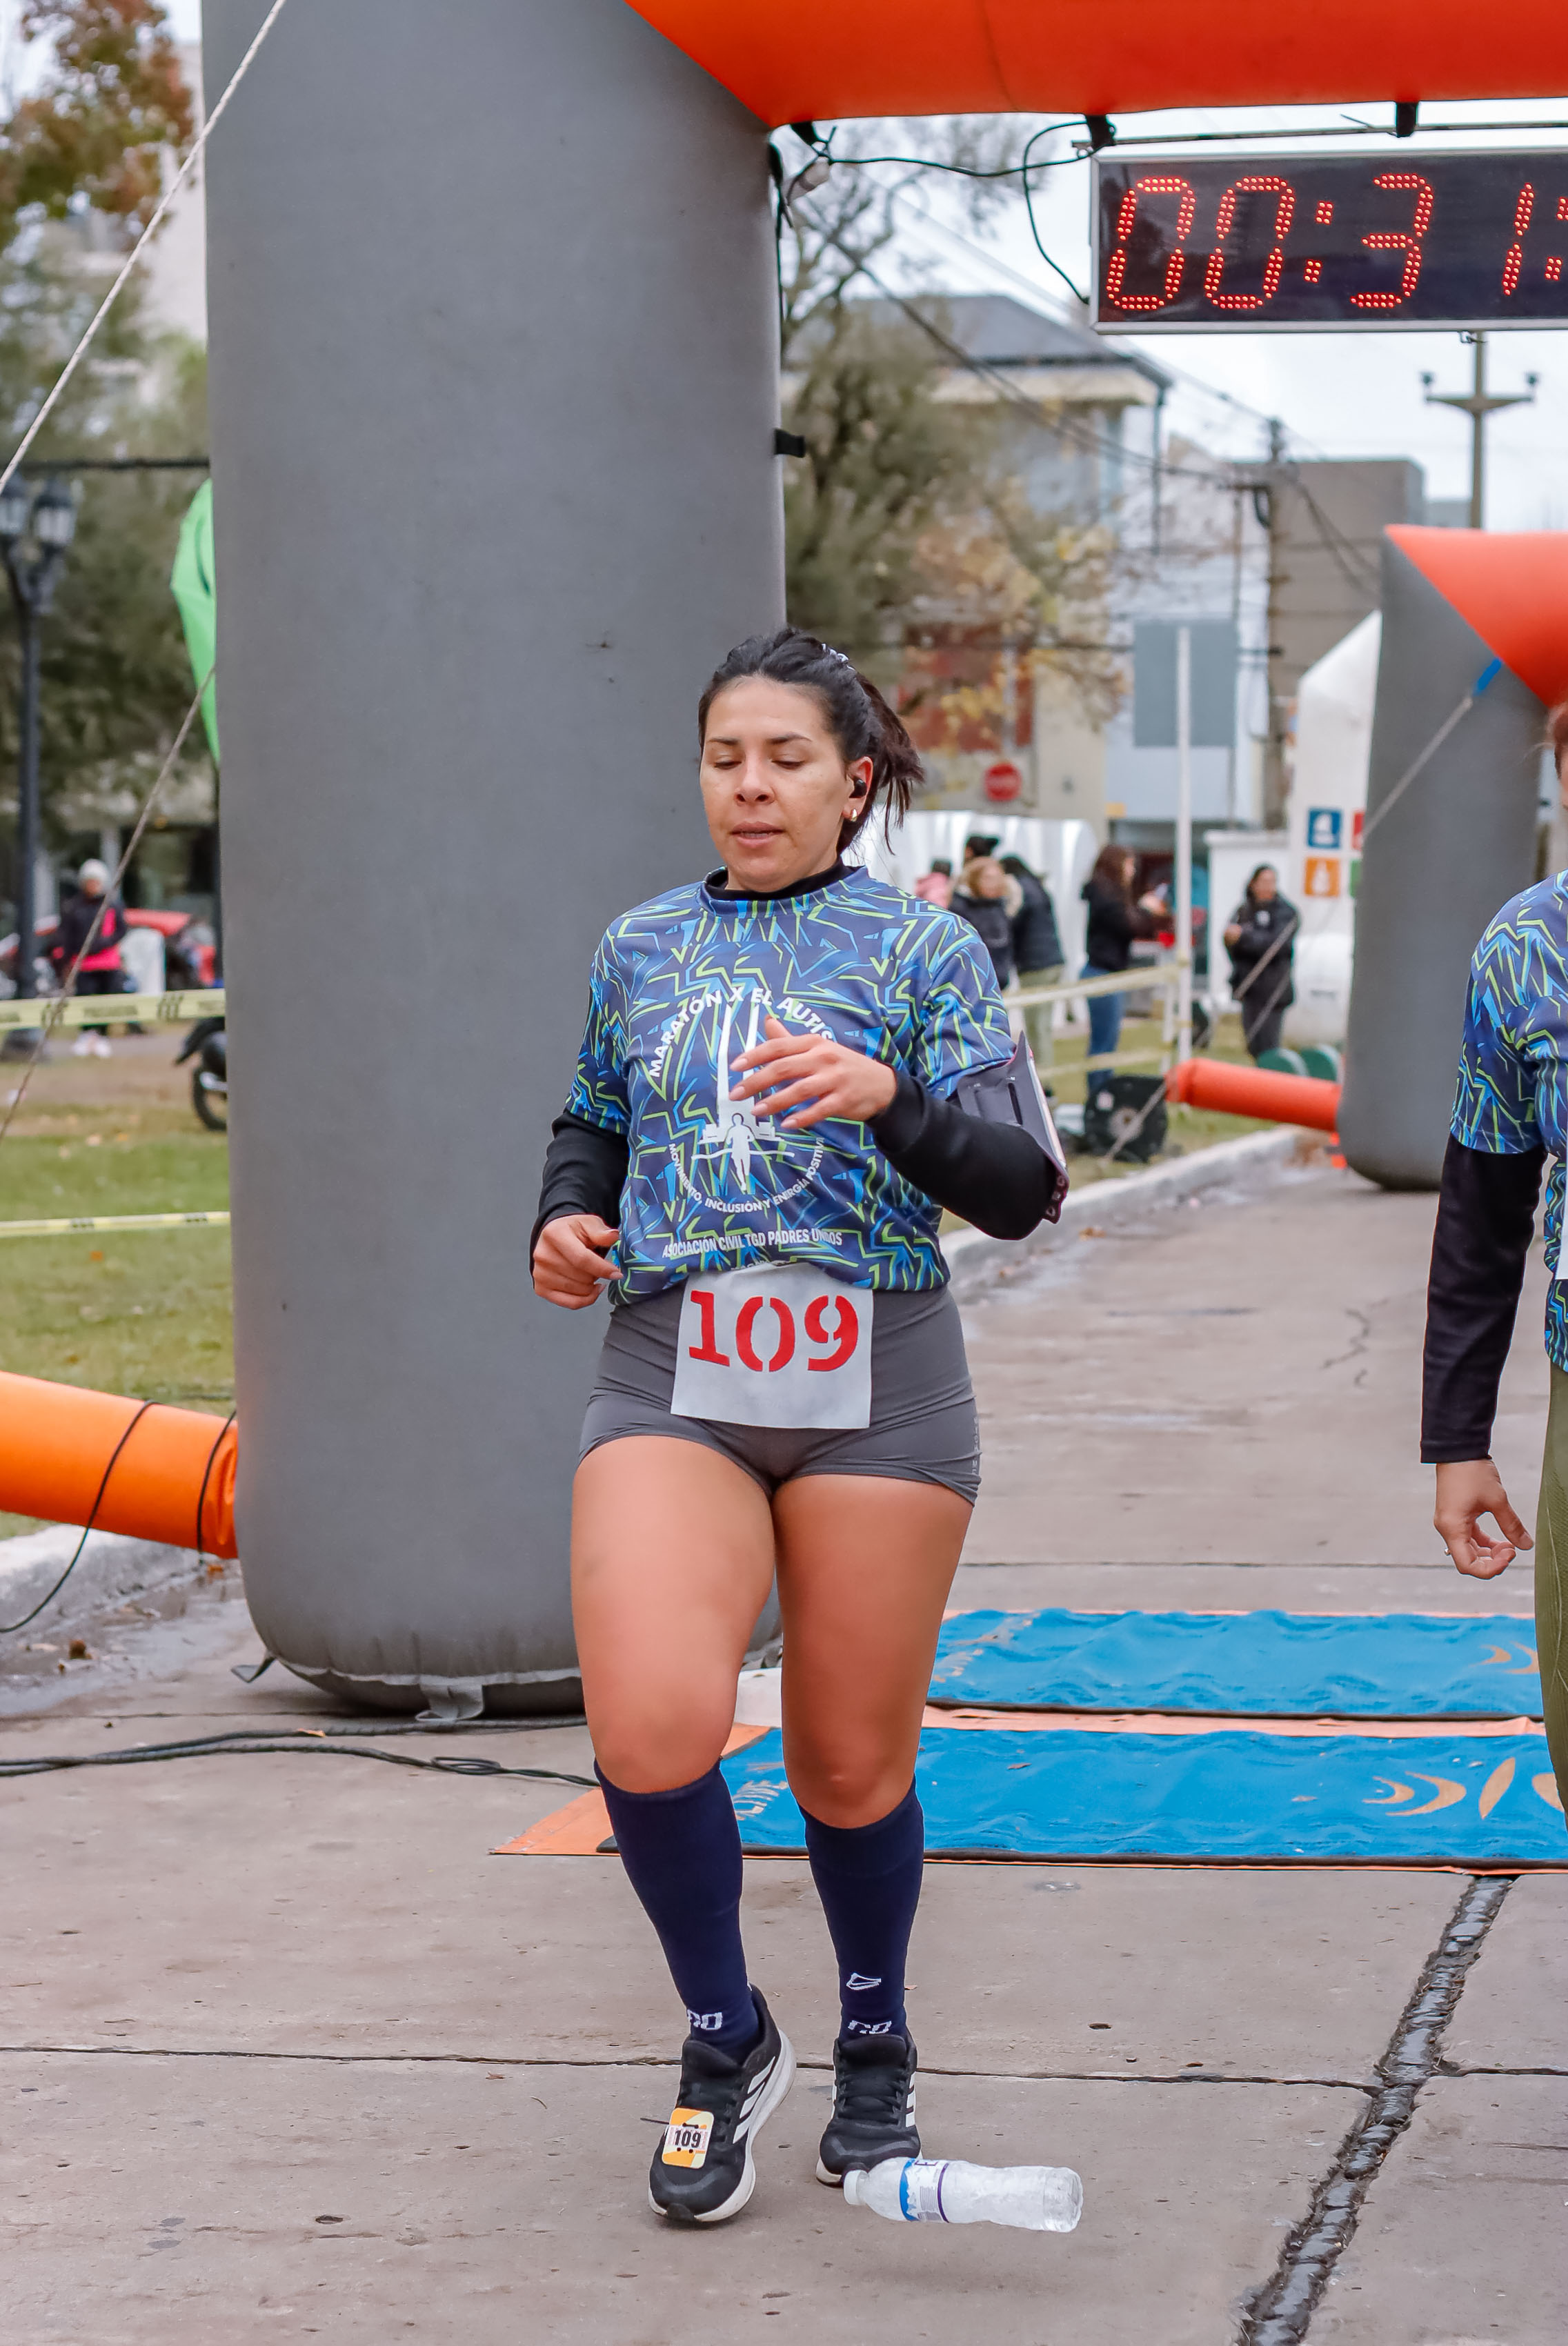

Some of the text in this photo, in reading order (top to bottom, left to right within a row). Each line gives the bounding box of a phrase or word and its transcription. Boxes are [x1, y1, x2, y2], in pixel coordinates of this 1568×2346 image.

[648, 989, 722, 1077] MARATÓN
[728, 986, 745, 1002] X
[750, 987, 773, 1006] EL
[704, 1197, 763, 1213] INCLUSIÓN
[762, 1197, 771, 1209] Y
[662, 1235, 718, 1258] ASOCIACIÓN
[718, 1235, 746, 1251] CIVIL
[744, 1232, 766, 1247] TGD
[767, 1229, 810, 1246] PADRES
[688, 1289, 859, 1372] 109
[674, 2129, 702, 2148] 109
